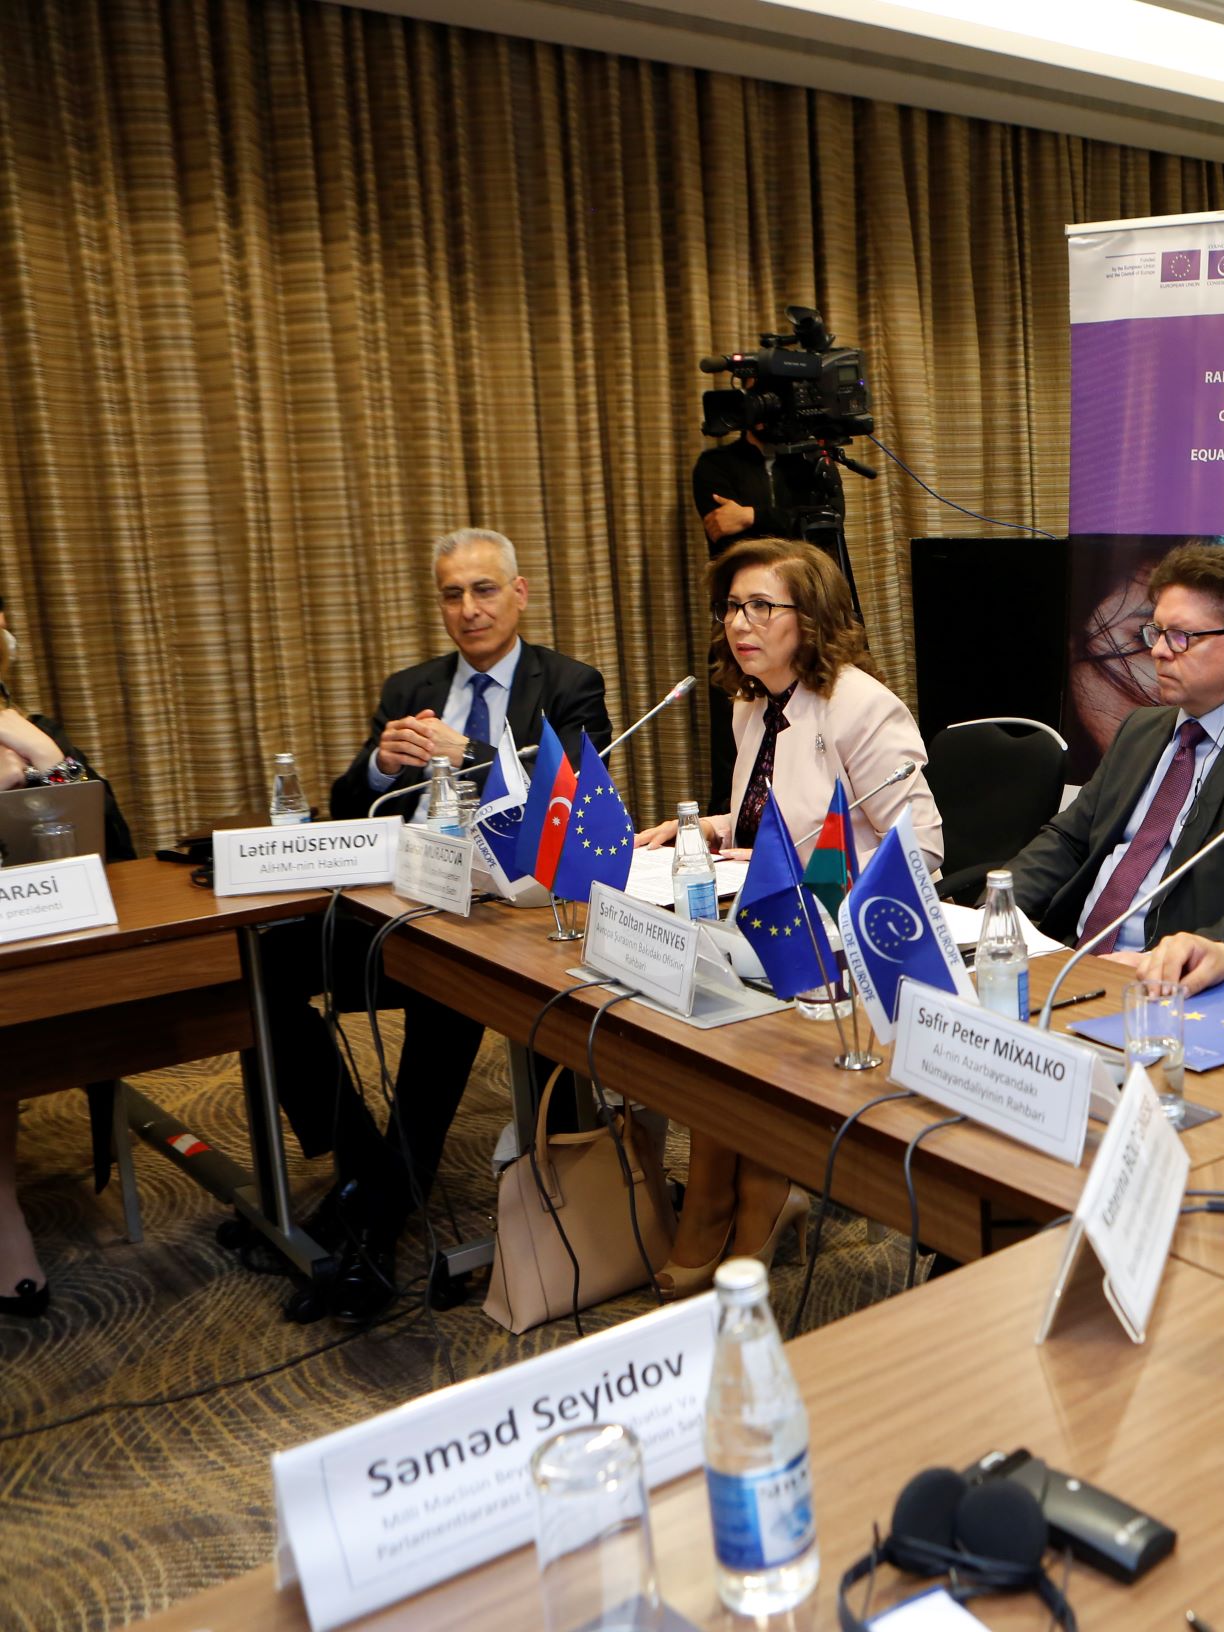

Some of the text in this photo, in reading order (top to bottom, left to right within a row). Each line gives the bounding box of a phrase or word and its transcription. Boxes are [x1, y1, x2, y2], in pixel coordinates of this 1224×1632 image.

[239, 834, 379, 858] Lətif HÜSEYNOV
[473, 835, 497, 869] L'EUROPE
[619, 910, 644, 933] Zoltan
[645, 921, 686, 952] HERNYES
[909, 850, 960, 966] COUNCIL OF EUROPE
[845, 933, 855, 949] DE
[849, 951, 875, 1002] L'EUROPE
[917, 1007, 1066, 1081] Səfir Peter MİXALKO
[367, 1353, 683, 1499] Səməd Seyidov
